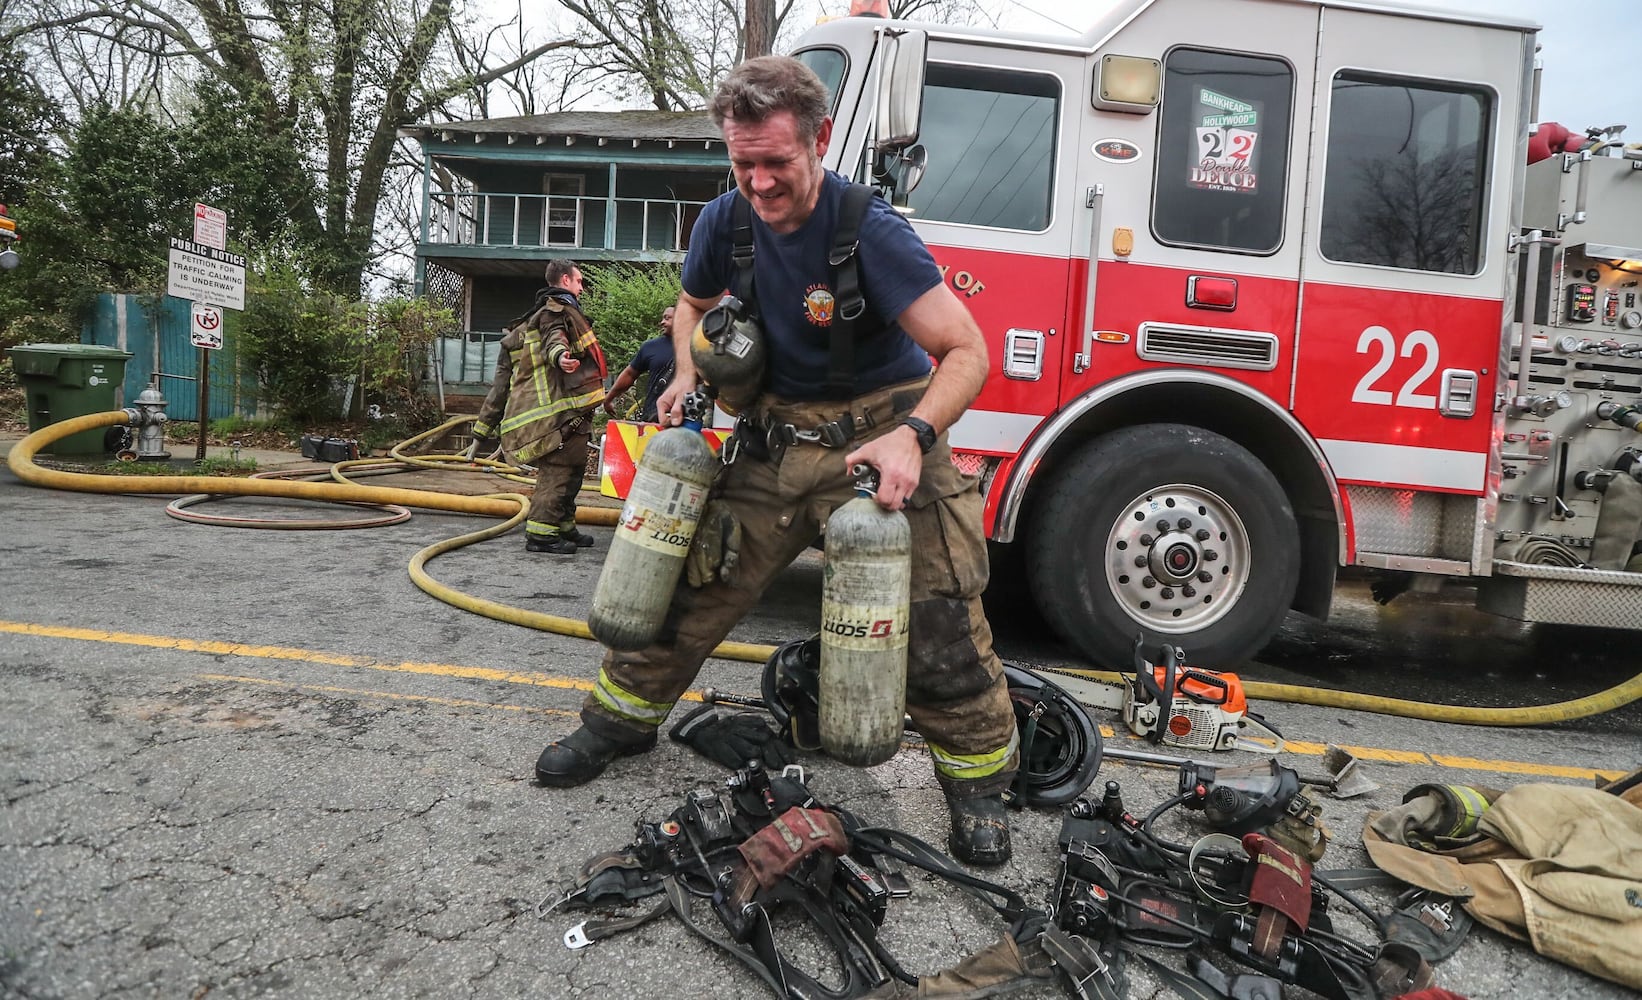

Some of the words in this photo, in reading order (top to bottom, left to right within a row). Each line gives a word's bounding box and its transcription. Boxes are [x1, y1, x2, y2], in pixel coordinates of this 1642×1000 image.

[1202, 92, 1244, 112] BANKHEAD
[1204, 114, 1248, 126] HOLLYWOOD
[1202, 132, 1222, 158] 2
[1228, 136, 1252, 160] 2
[1200, 158, 1250, 172] Double
[1190, 168, 1256, 188] DEUCE
[171, 238, 207, 256] PUBLIC
[212, 249, 245, 265] NOTICE
[172, 262, 206, 276] TRAFFIC
[208, 271, 242, 285] CALMING
[182, 254, 216, 268] PETITION
[220, 264, 235, 274] FOR
[192, 276, 234, 291] UNDERWAY
[952, 270, 986, 298] OF
[1352, 326, 1440, 410] 22
[650, 532, 690, 546] SCOTT
[824, 622, 869, 638] SCOTT
